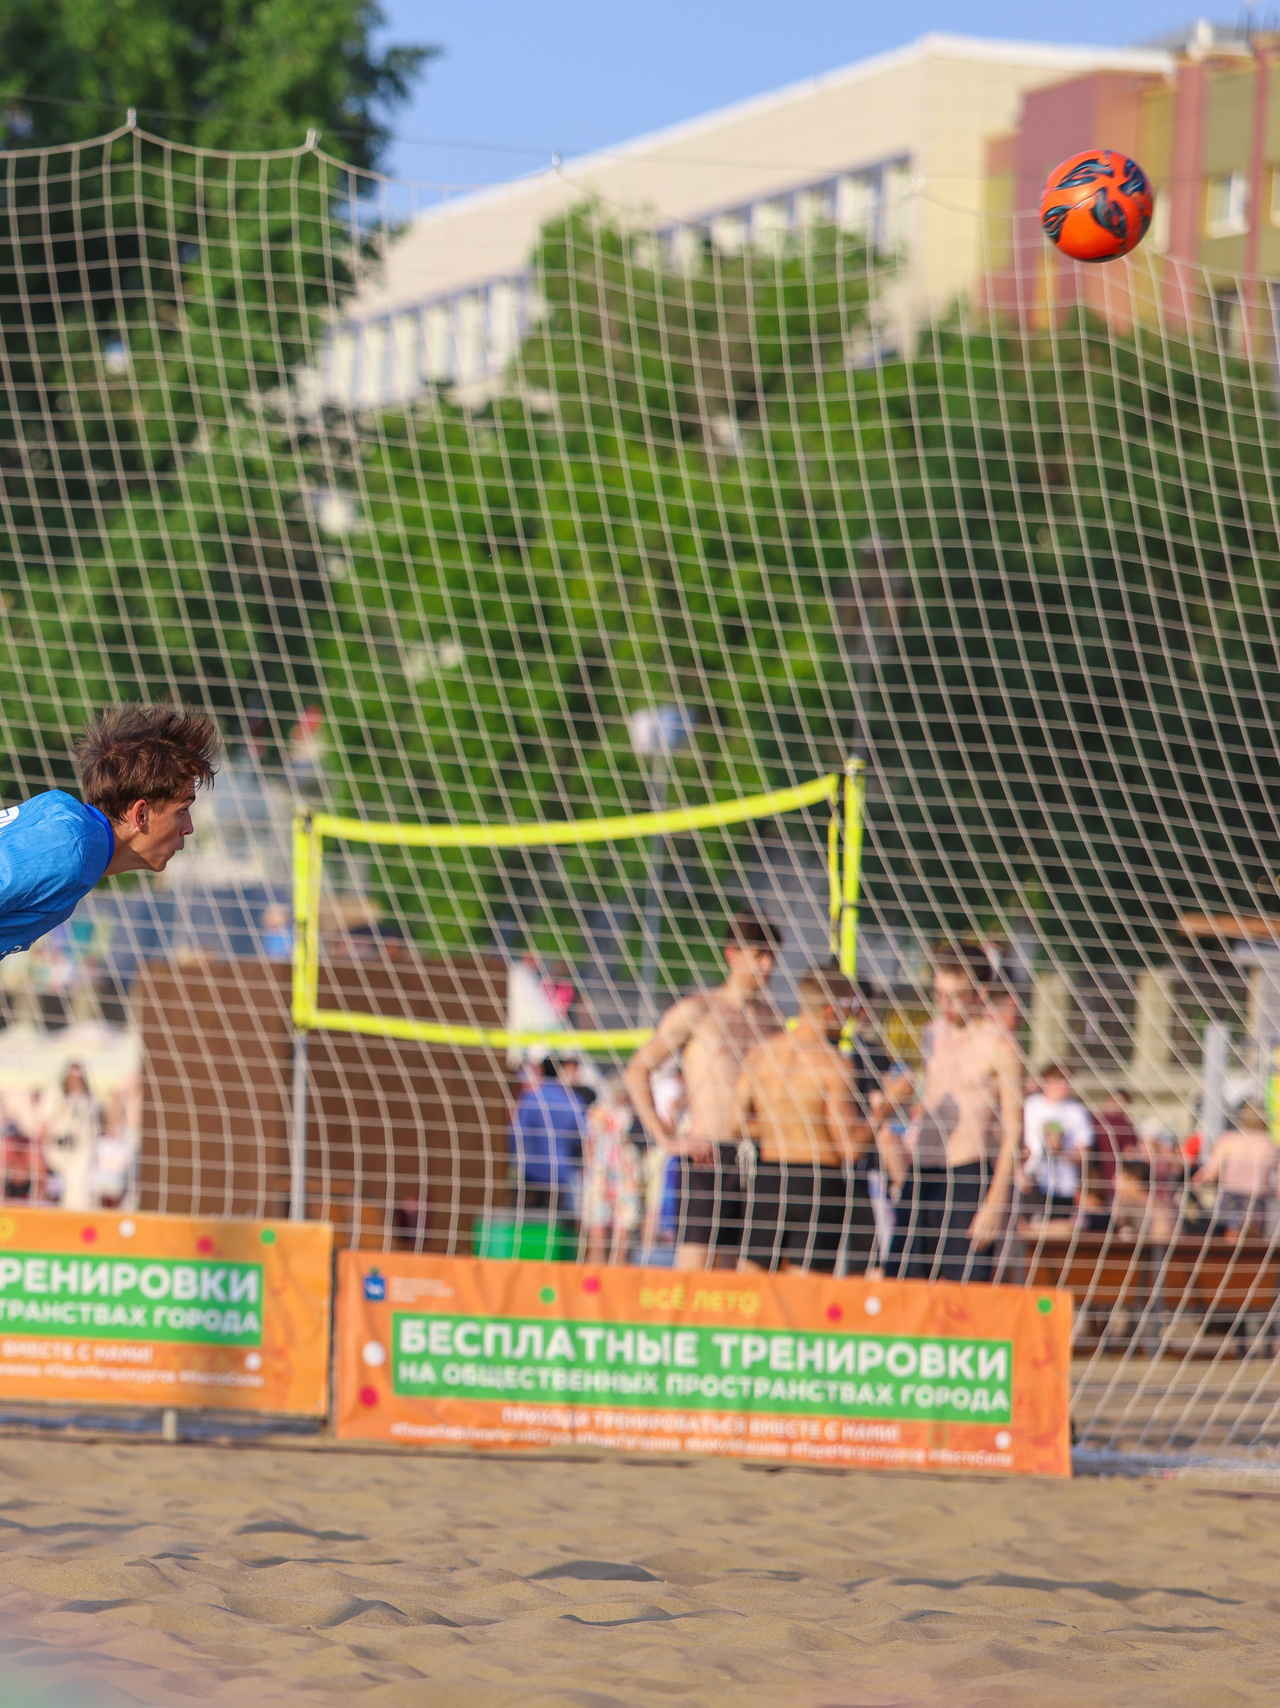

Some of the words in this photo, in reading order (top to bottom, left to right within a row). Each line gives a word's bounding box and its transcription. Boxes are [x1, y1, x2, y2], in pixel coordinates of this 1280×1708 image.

[639, 1283, 686, 1311] ВСЁ
[693, 1288, 761, 1316] ЛЕТО
[152, 1305, 261, 1335] ГОРОДА
[77, 1343, 92, 1362] С
[399, 1318, 700, 1367] БЕСПЛАТНЫЕ
[711, 1332, 1008, 1382] ТРЕНИРОВКИ
[398, 1360, 437, 1385] НА
[442, 1362, 660, 1395] ОБЩЕСТВЕННЫХ
[665, 1372, 895, 1406] ПРОСТРАНСТВАХ
[900, 1383, 1010, 1413] ГОРОДА
[501, 1406, 590, 1429] ПРИХОДИ
[592, 1411, 746, 1435] ТРЕНИРОВАТЬСЯ
[749, 1418, 820, 1439] ВМЕСТЕ
[824, 1421, 839, 1441] С
